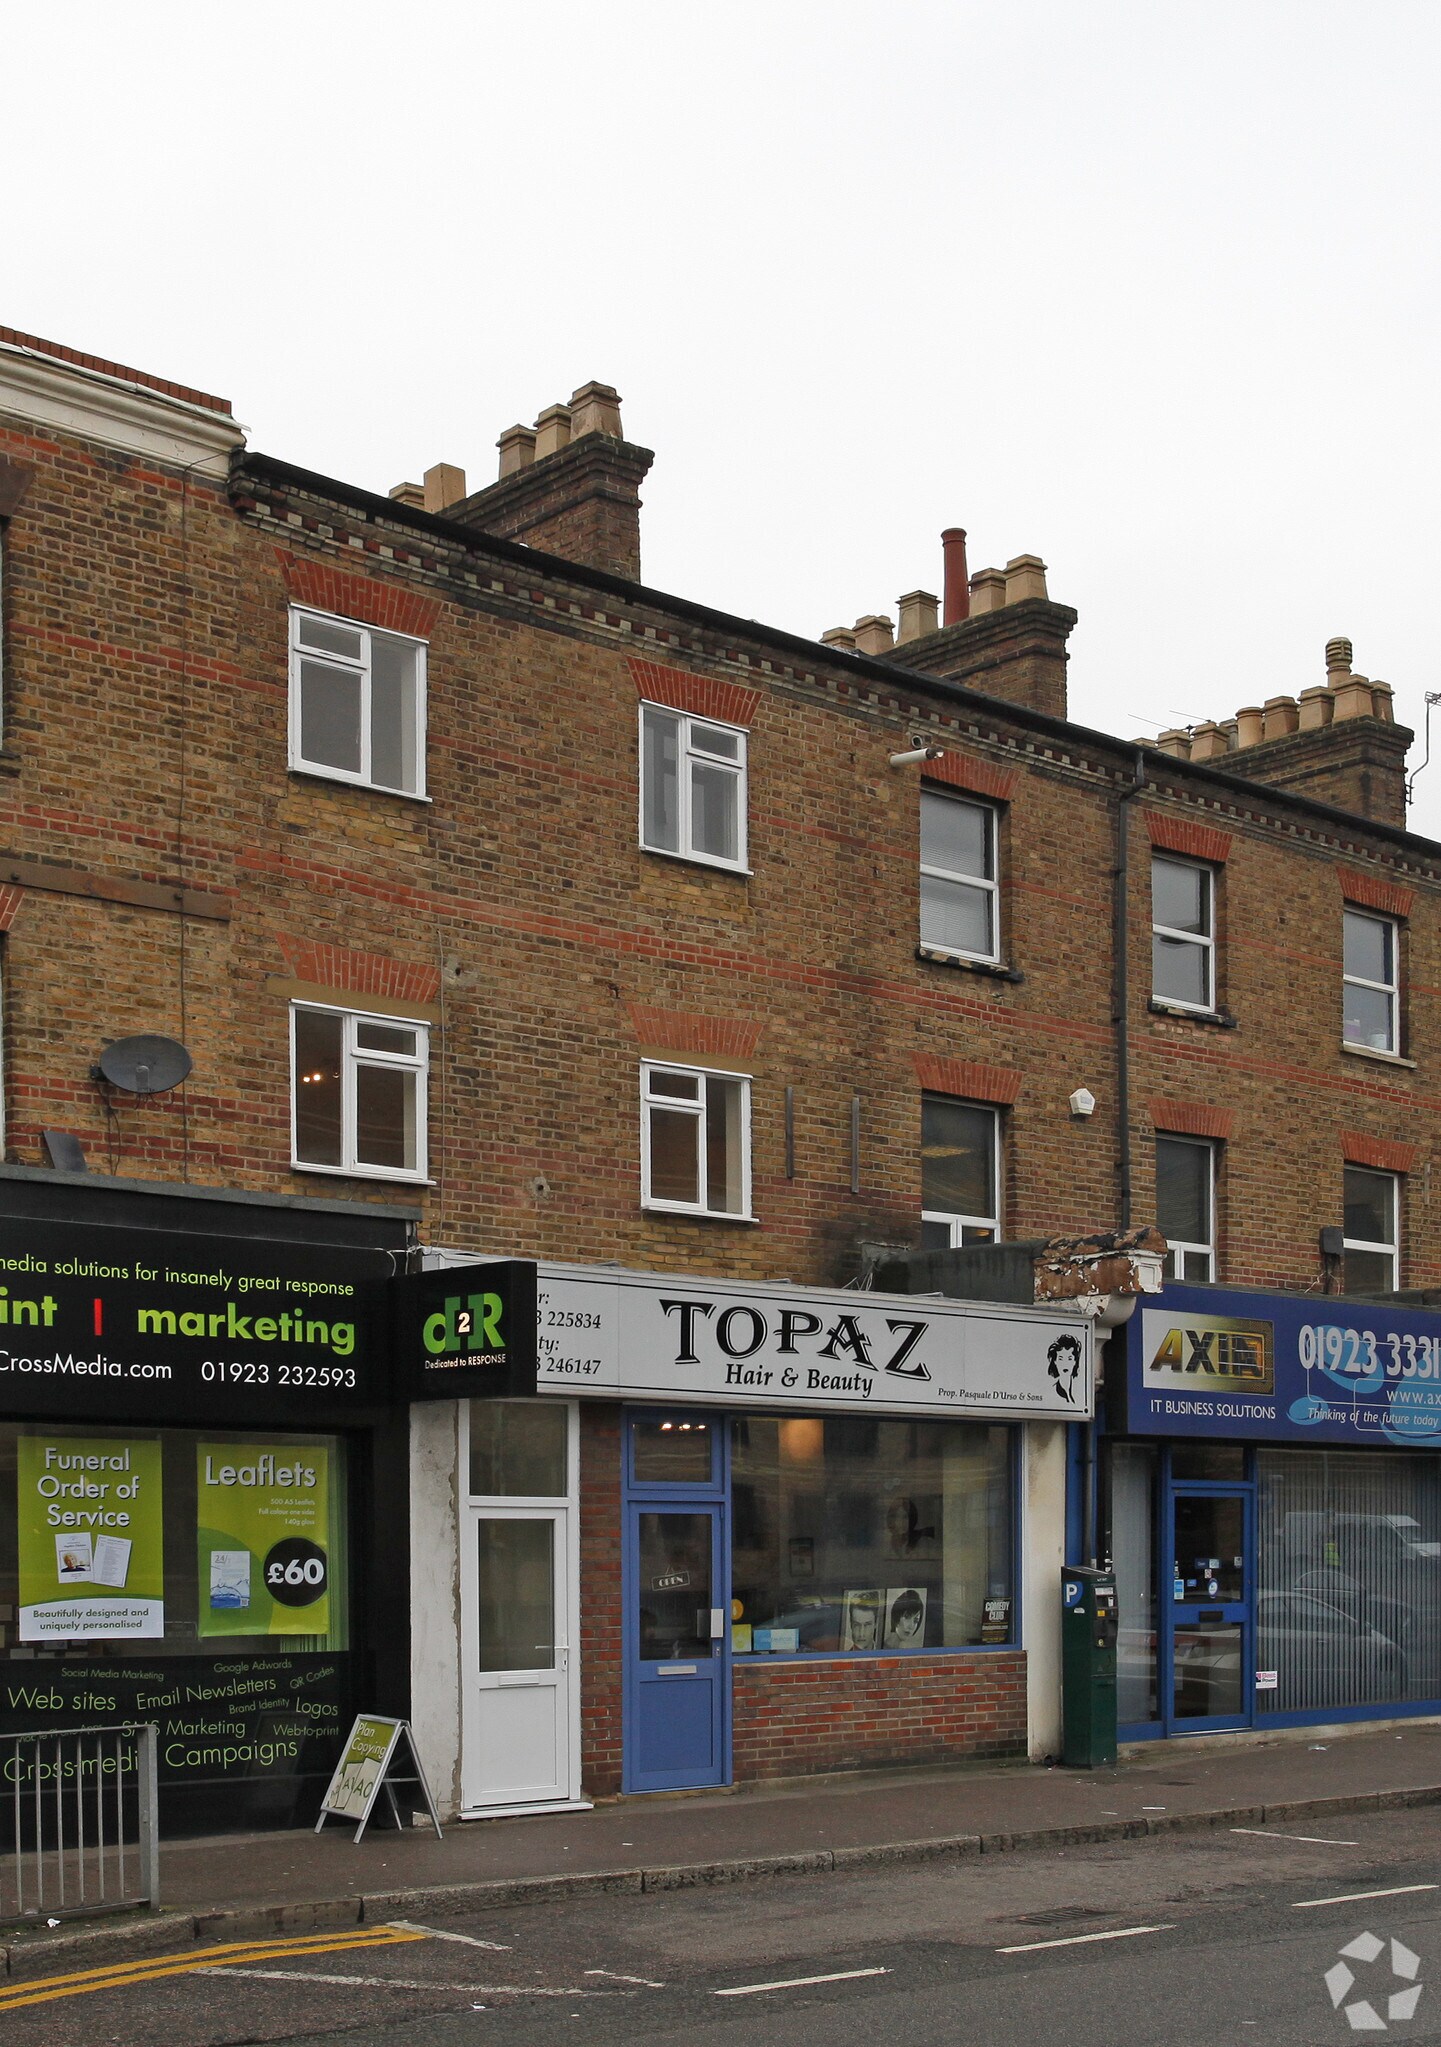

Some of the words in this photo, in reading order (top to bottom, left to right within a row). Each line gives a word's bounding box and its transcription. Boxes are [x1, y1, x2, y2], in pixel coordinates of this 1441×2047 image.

[54, 1257, 129, 1279] solutions
[135, 1262, 158, 1281] for
[165, 1267, 233, 1291] insanely
[238, 1277, 281, 1293] great
[286, 1280, 354, 1297] response
[138, 1302, 355, 1356] marketing
[547, 1311, 602, 1329] 225834
[659, 1299, 932, 1381] TOPAZ
[1298, 1324, 1377, 1374] 01923
[424, 1357, 459, 1369] Dedicated
[459, 1357, 467, 1367] to
[468, 1353, 506, 1366] RESPONSE
[546, 1357, 602, 1375] 246147
[201, 1361, 270, 1383] 01923
[278, 1365, 356, 1388] 232593
[725, 1363, 774, 1387] Hair
[781, 1367, 799, 1387] &
[807, 1369, 873, 1398] Beauty
[938, 1387, 958, 1399] Prop.
[959, 1389, 991, 1401] Pasquale
[1018, 1392, 1025, 1401] &
[1026, 1392, 1043, 1401] Sons
[1150, 1399, 1162, 1413] IT
[1165, 1400, 1214, 1416] BUSINESS
[1216, 1403, 1276, 1419] SOLUTIONS
[1308, 1407, 1346, 1423] Thinking
[1349, 1410, 1360, 1424] of
[1363, 1410, 1378, 1422] the
[1382, 1411, 1409, 1425] future
[1413, 1415, 1439, 1428] today
[45, 1447, 130, 1471] Funeral
[205, 1454, 317, 1487] Leaflets
[37, 1474, 110, 1498] Order
[116, 1476, 140, 1499] of
[47, 1503, 130, 1527] Service
[268, 1558, 325, 1585] £60
[1066, 1583, 1078, 1602] P
[33, 1609, 83, 1619] Beautifully
[85, 1608, 128, 1618] designed
[131, 1608, 149, 1616] and
[985, 1601, 1010, 1611] COMEDY
[989, 1611, 1005, 1620] CLUB
[40, 1621, 80, 1631] uniquely
[82, 1620, 142, 1630] personalised
[61, 1668, 89, 1678] Social
[90, 1669, 119, 1679] Media
[121, 1670, 165, 1682] Marketing
[213, 1661, 249, 1675] Google
[252, 1659, 293, 1670] Adwords
[289, 1677, 304, 1689] QR
[306, 1665, 335, 1684] Codes
[7, 1686, 64, 1710] Web
[72, 1692, 116, 1711] sites
[136, 1687, 180, 1710] Email
[186, 1677, 277, 1702] Newsletters
[229, 1702, 256, 1715] Brand
[259, 1698, 290, 1709] Identity
[296, 1697, 338, 1719] Logos
[166, 1718, 246, 1738] Marketing
[273, 1724, 339, 1738] Web-to-print
[357, 1722, 375, 1737] Plan
[165, 1740, 298, 1769] Campaigns
[352, 1737, 387, 1758] Copying
